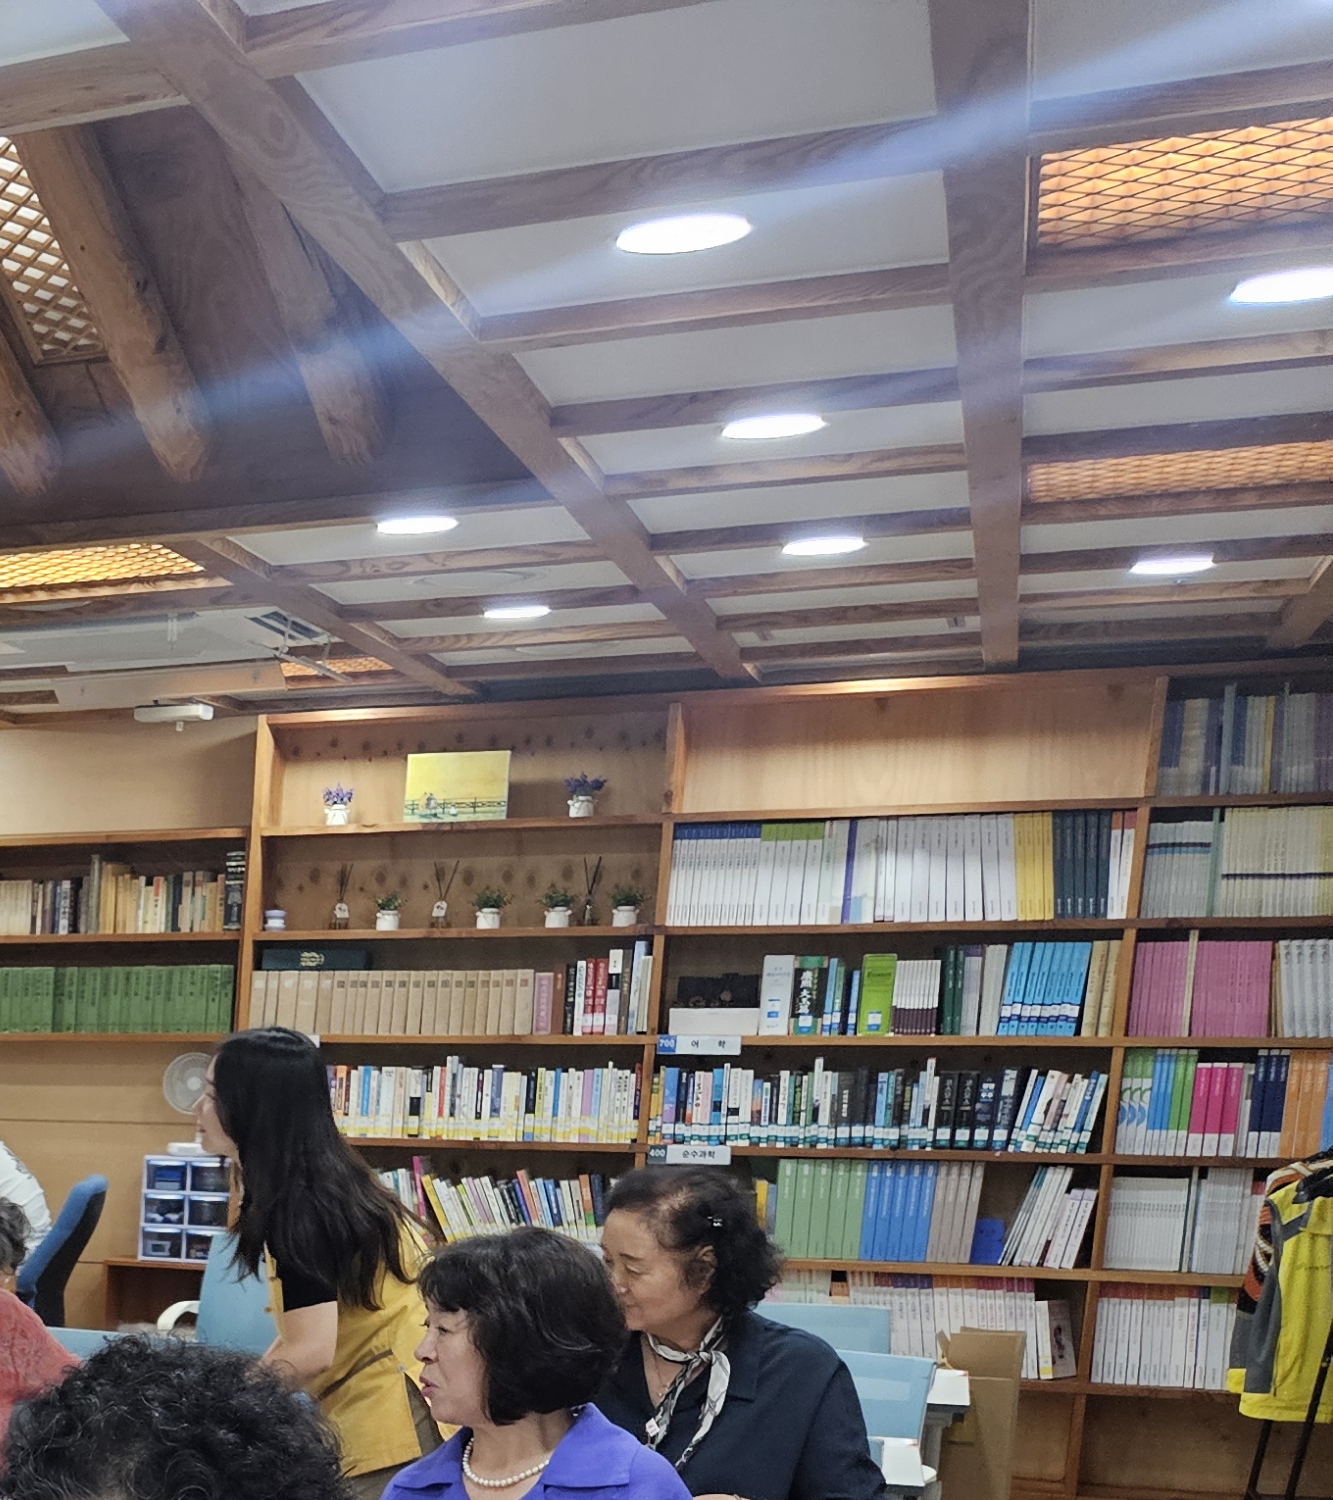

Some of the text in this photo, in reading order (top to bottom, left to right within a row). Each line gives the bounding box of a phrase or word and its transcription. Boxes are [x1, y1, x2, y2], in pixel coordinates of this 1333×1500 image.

[659, 1039, 674, 1049] 700
[649, 1149, 715, 1159] 400 순수과학
